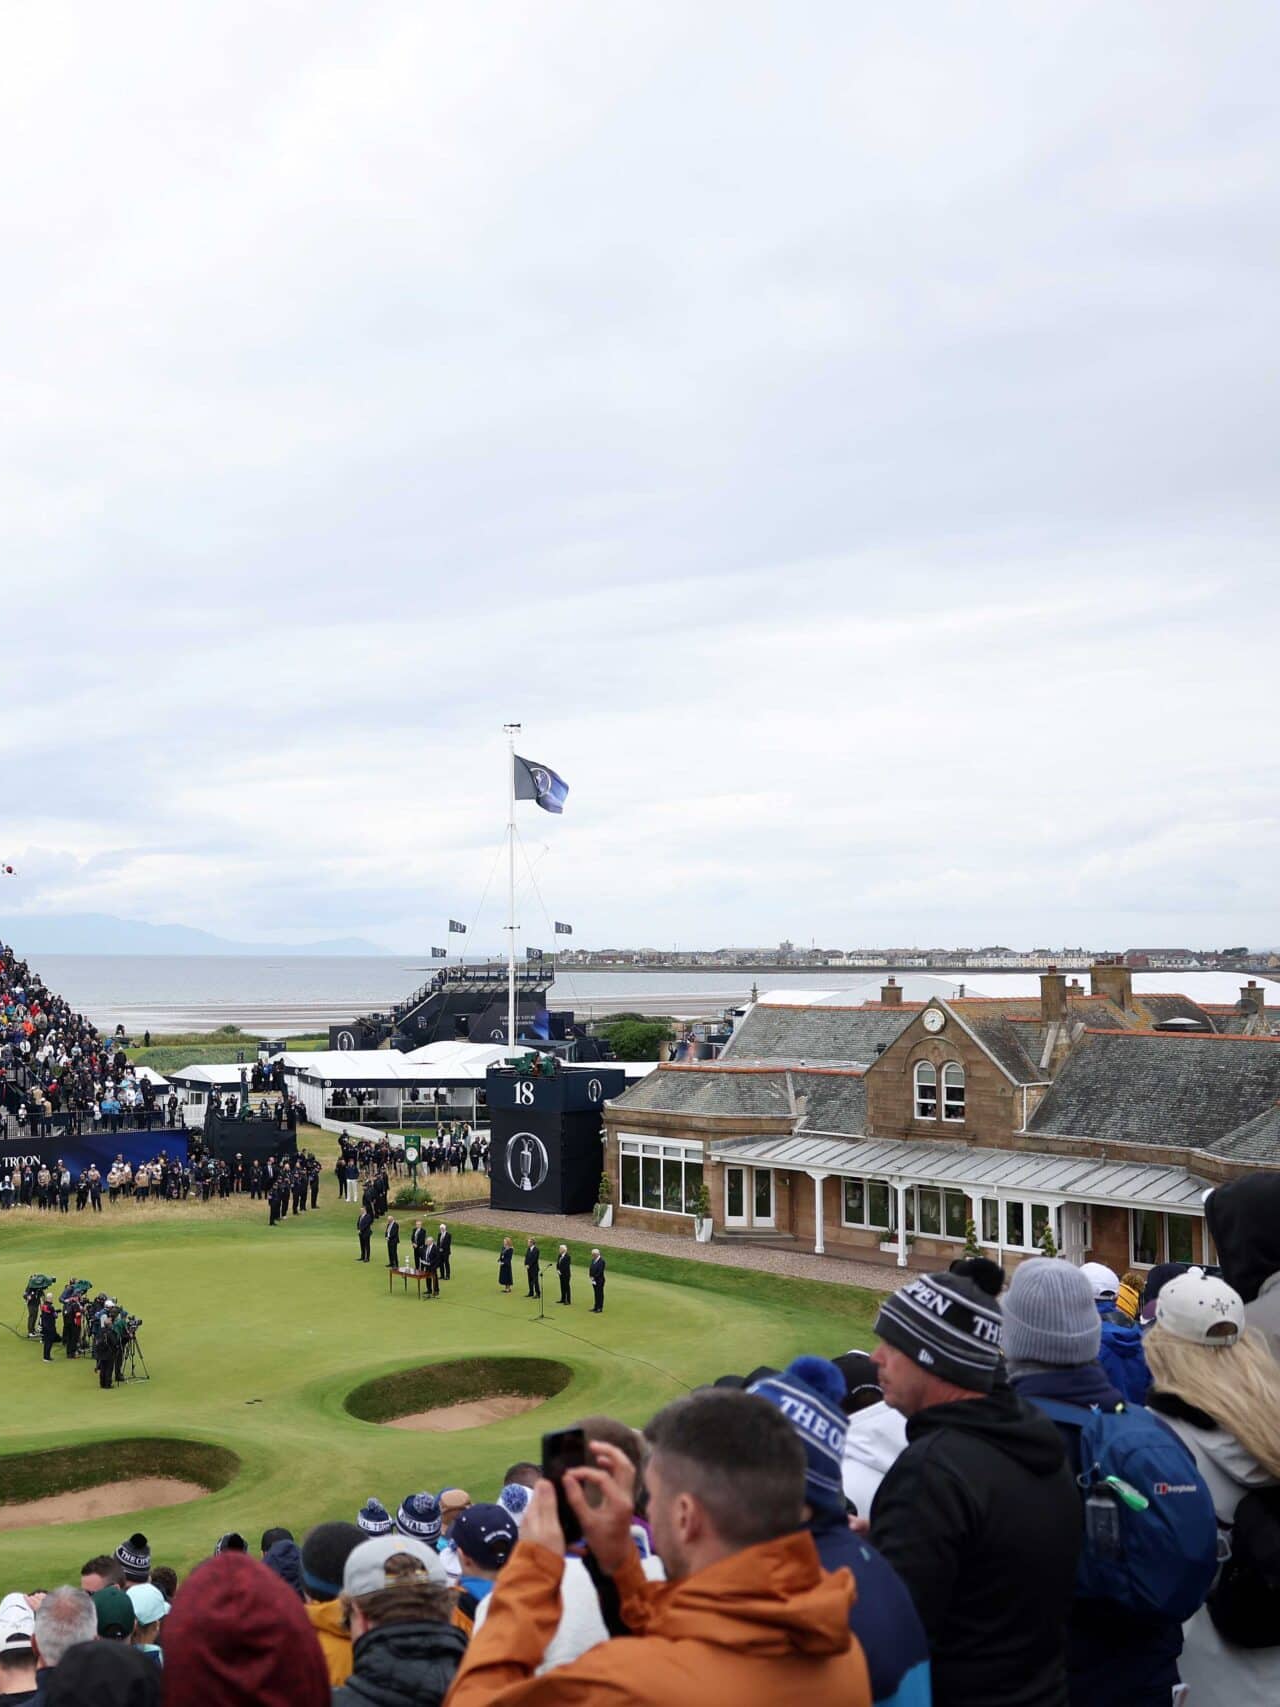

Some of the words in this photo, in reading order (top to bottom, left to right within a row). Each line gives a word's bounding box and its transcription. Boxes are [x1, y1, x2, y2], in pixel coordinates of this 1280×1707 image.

[512, 1081, 535, 1106] 18
[2, 1155, 41, 1168] TROON
[903, 1278, 952, 1316] PEN
[972, 1316, 1002, 1345] TH
